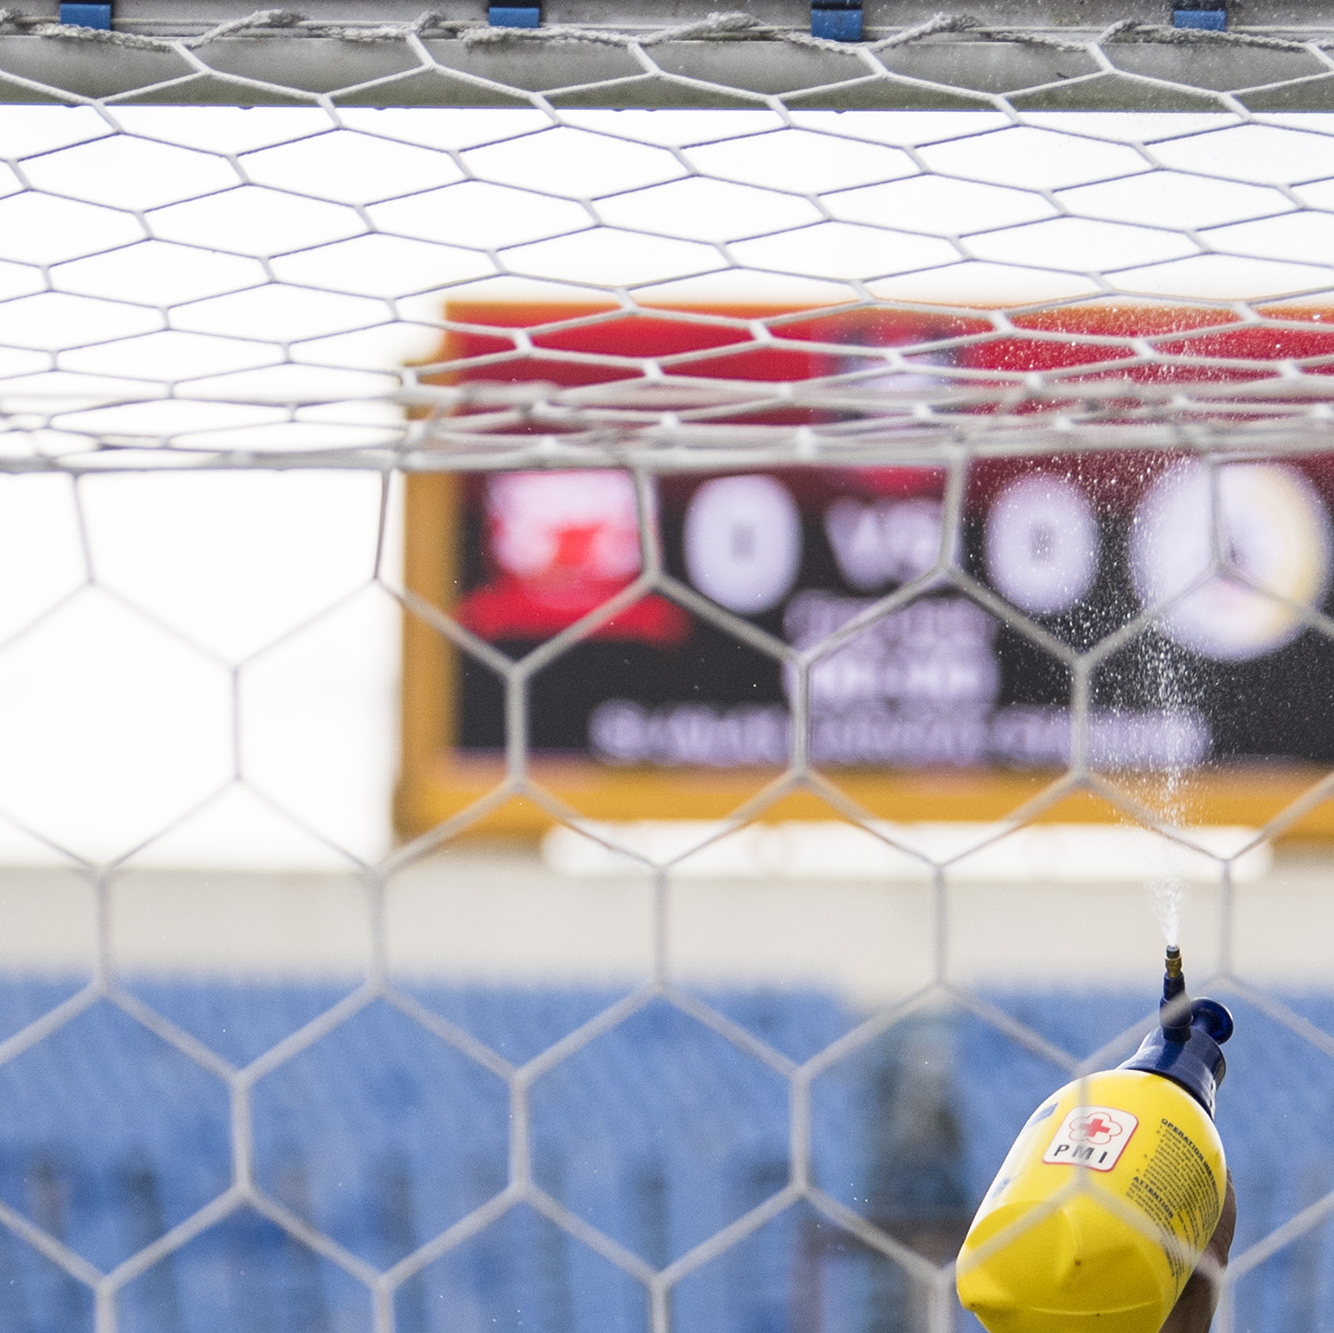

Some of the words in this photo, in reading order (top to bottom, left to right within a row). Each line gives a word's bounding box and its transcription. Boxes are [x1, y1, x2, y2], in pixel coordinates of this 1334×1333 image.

[1053, 1143, 1107, 1164] PMI
[1161, 1118, 1204, 1160] OPERATION
[1133, 1176, 1174, 1219] ATTENTION
